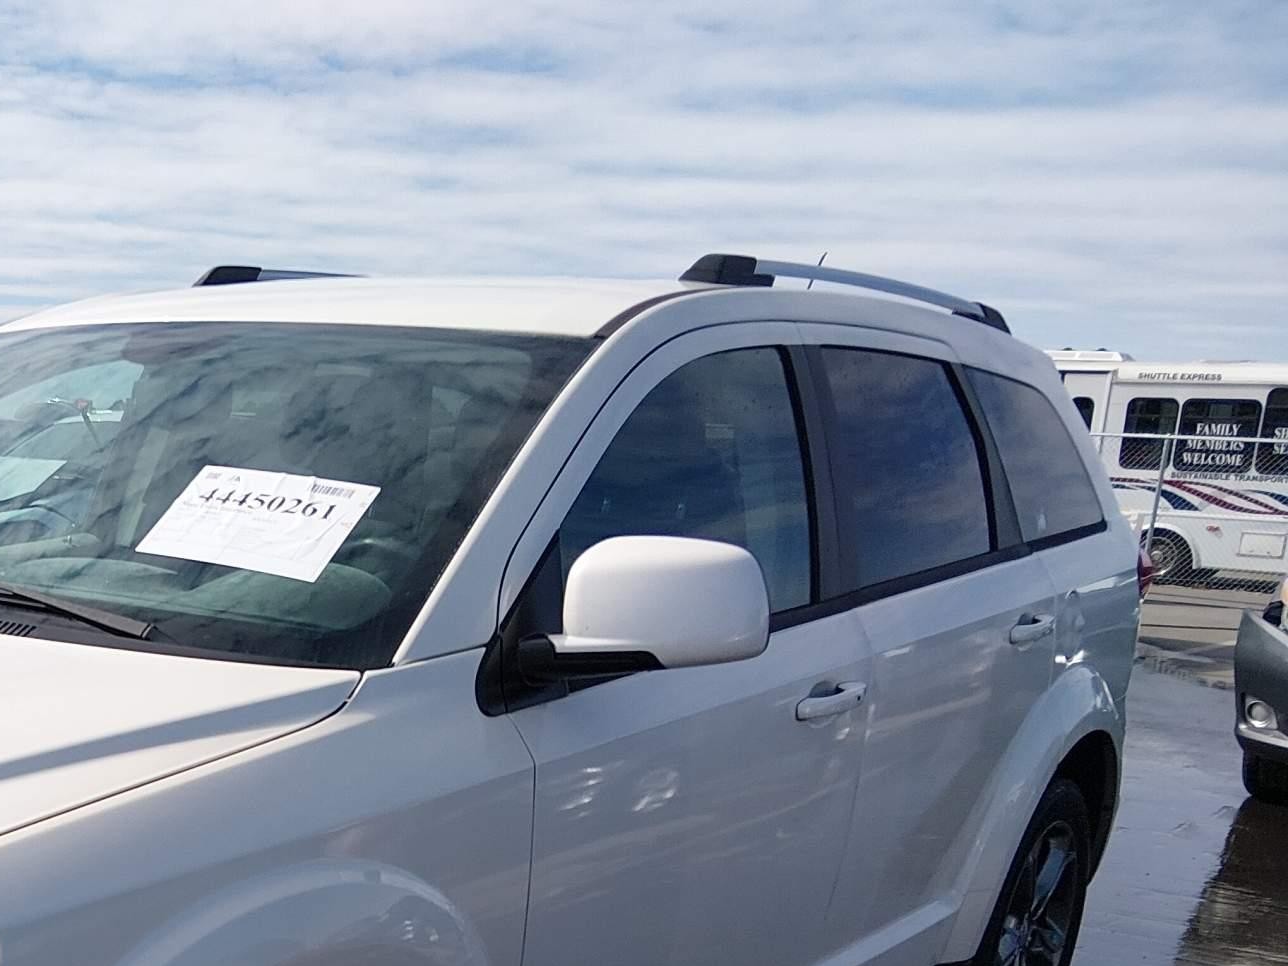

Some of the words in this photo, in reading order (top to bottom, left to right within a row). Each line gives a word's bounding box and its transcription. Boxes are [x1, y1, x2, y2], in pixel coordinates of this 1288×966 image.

[1138, 372, 1178, 380] SHUTTLE
[1180, 373, 1222, 381] EXPRESS
[1195, 423, 1242, 436] FAMILY
[1186, 439, 1245, 451] MEMBERS
[1182, 452, 1244, 466] WELCOME
[198, 488, 337, 520] 44450261
